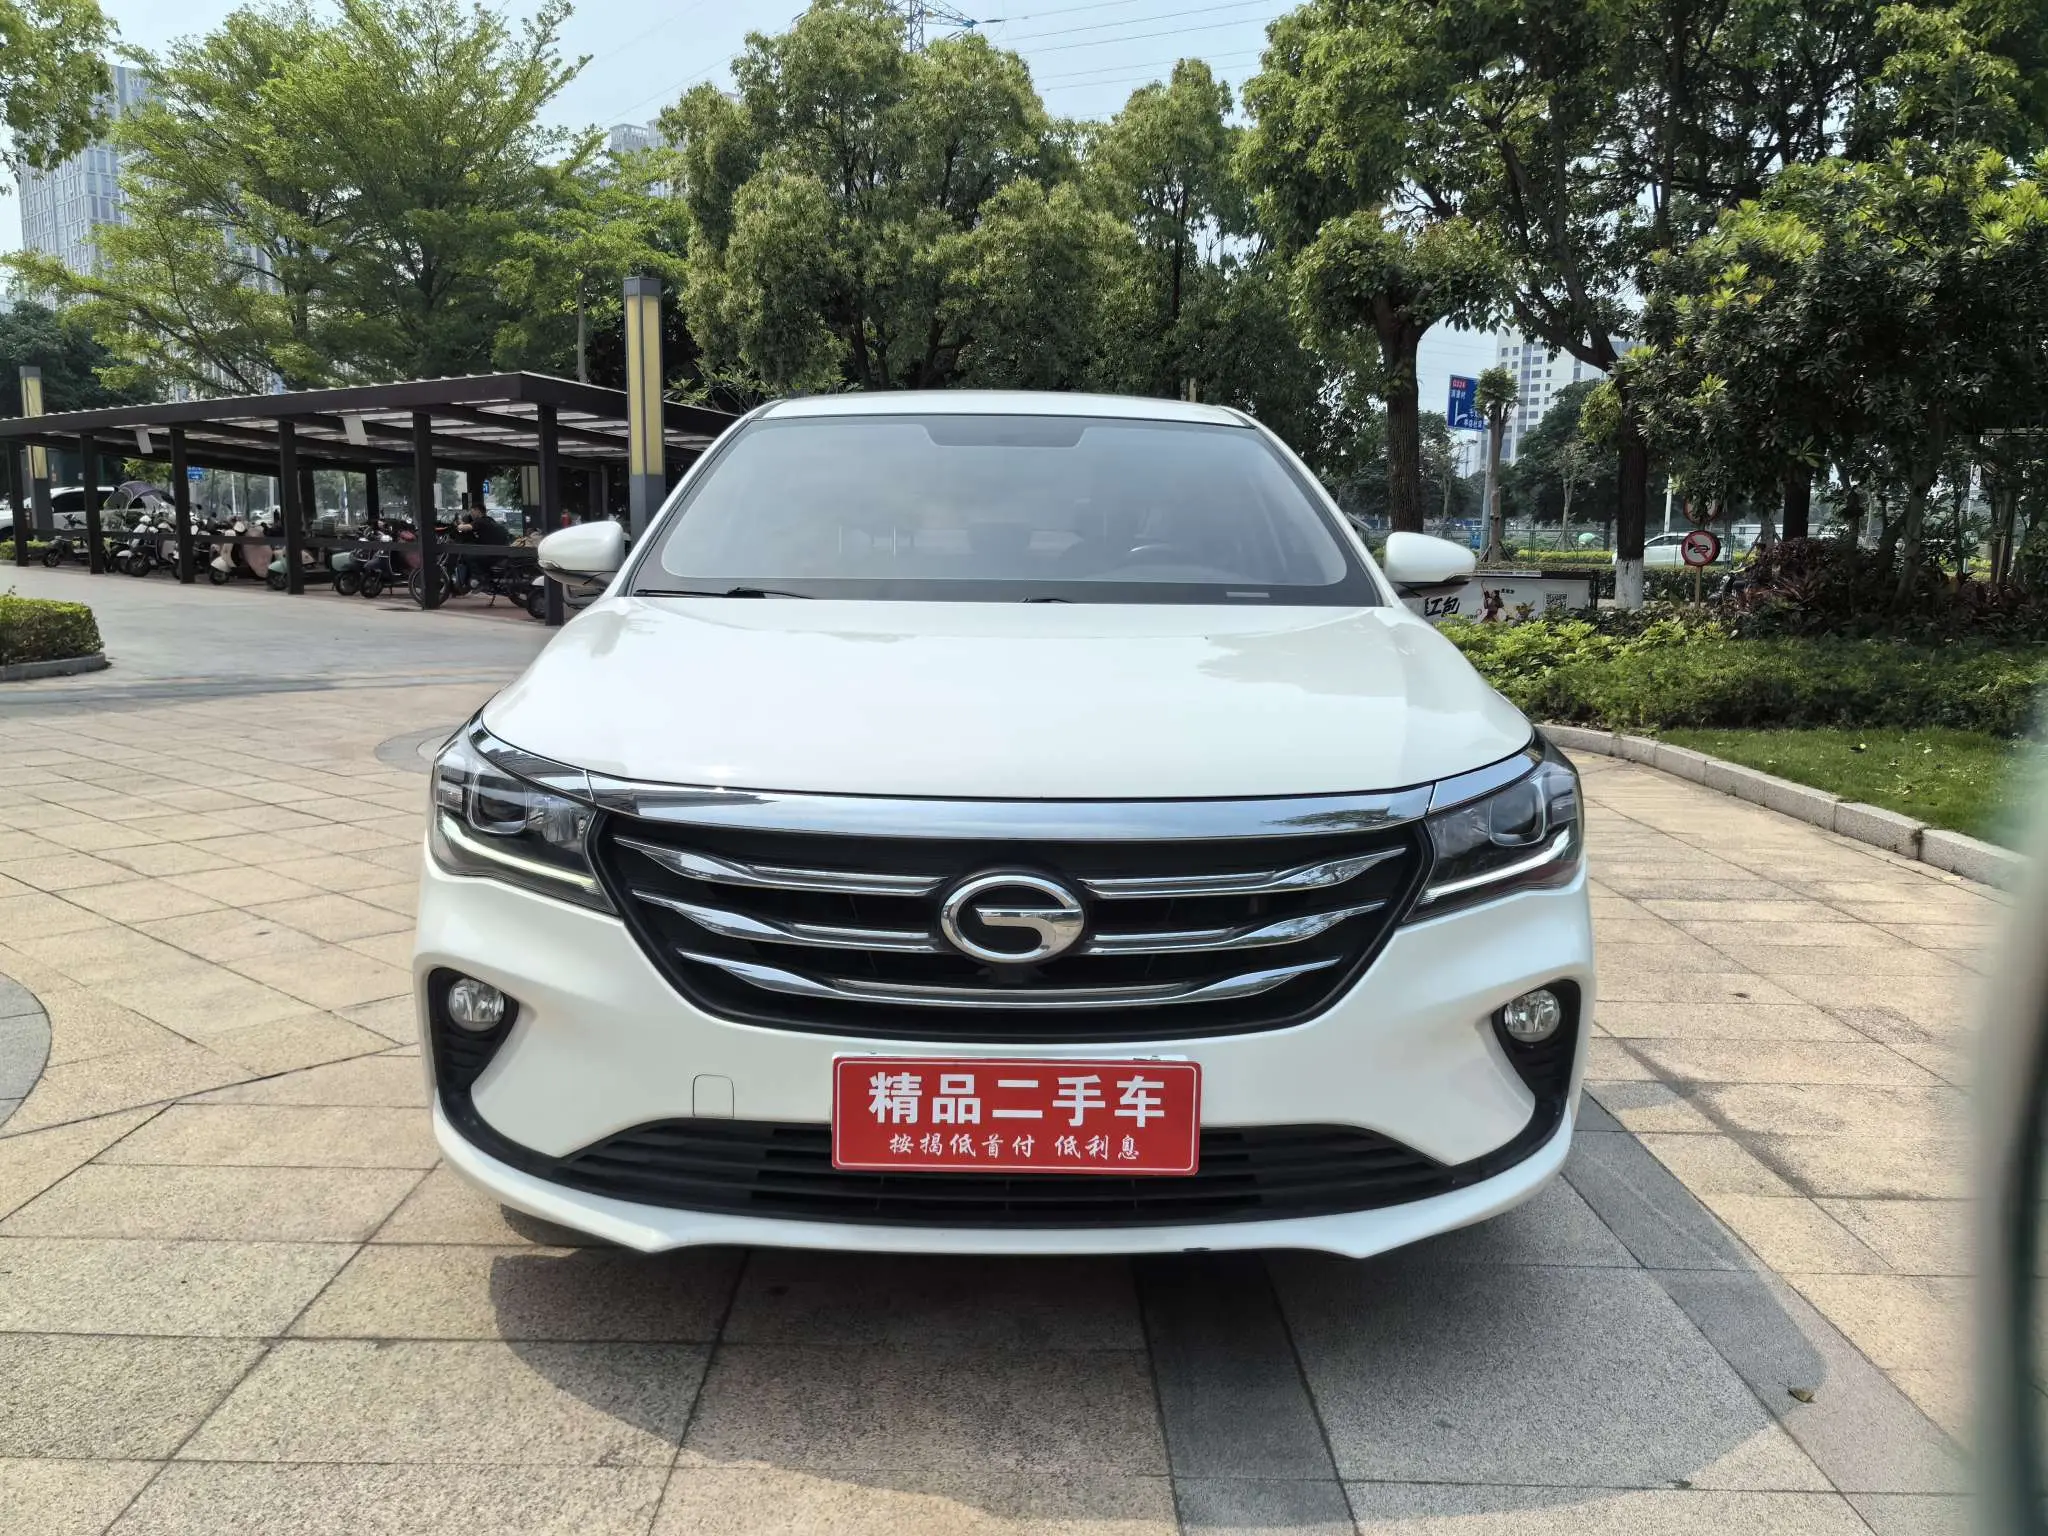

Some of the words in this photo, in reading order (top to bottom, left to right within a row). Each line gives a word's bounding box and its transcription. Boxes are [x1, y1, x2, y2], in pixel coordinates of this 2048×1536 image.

[868, 1071, 1166, 1128] 精品二手车
[889, 1132, 1036, 1159] 按揭低首付
[1054, 1133, 1140, 1161] 低利息
